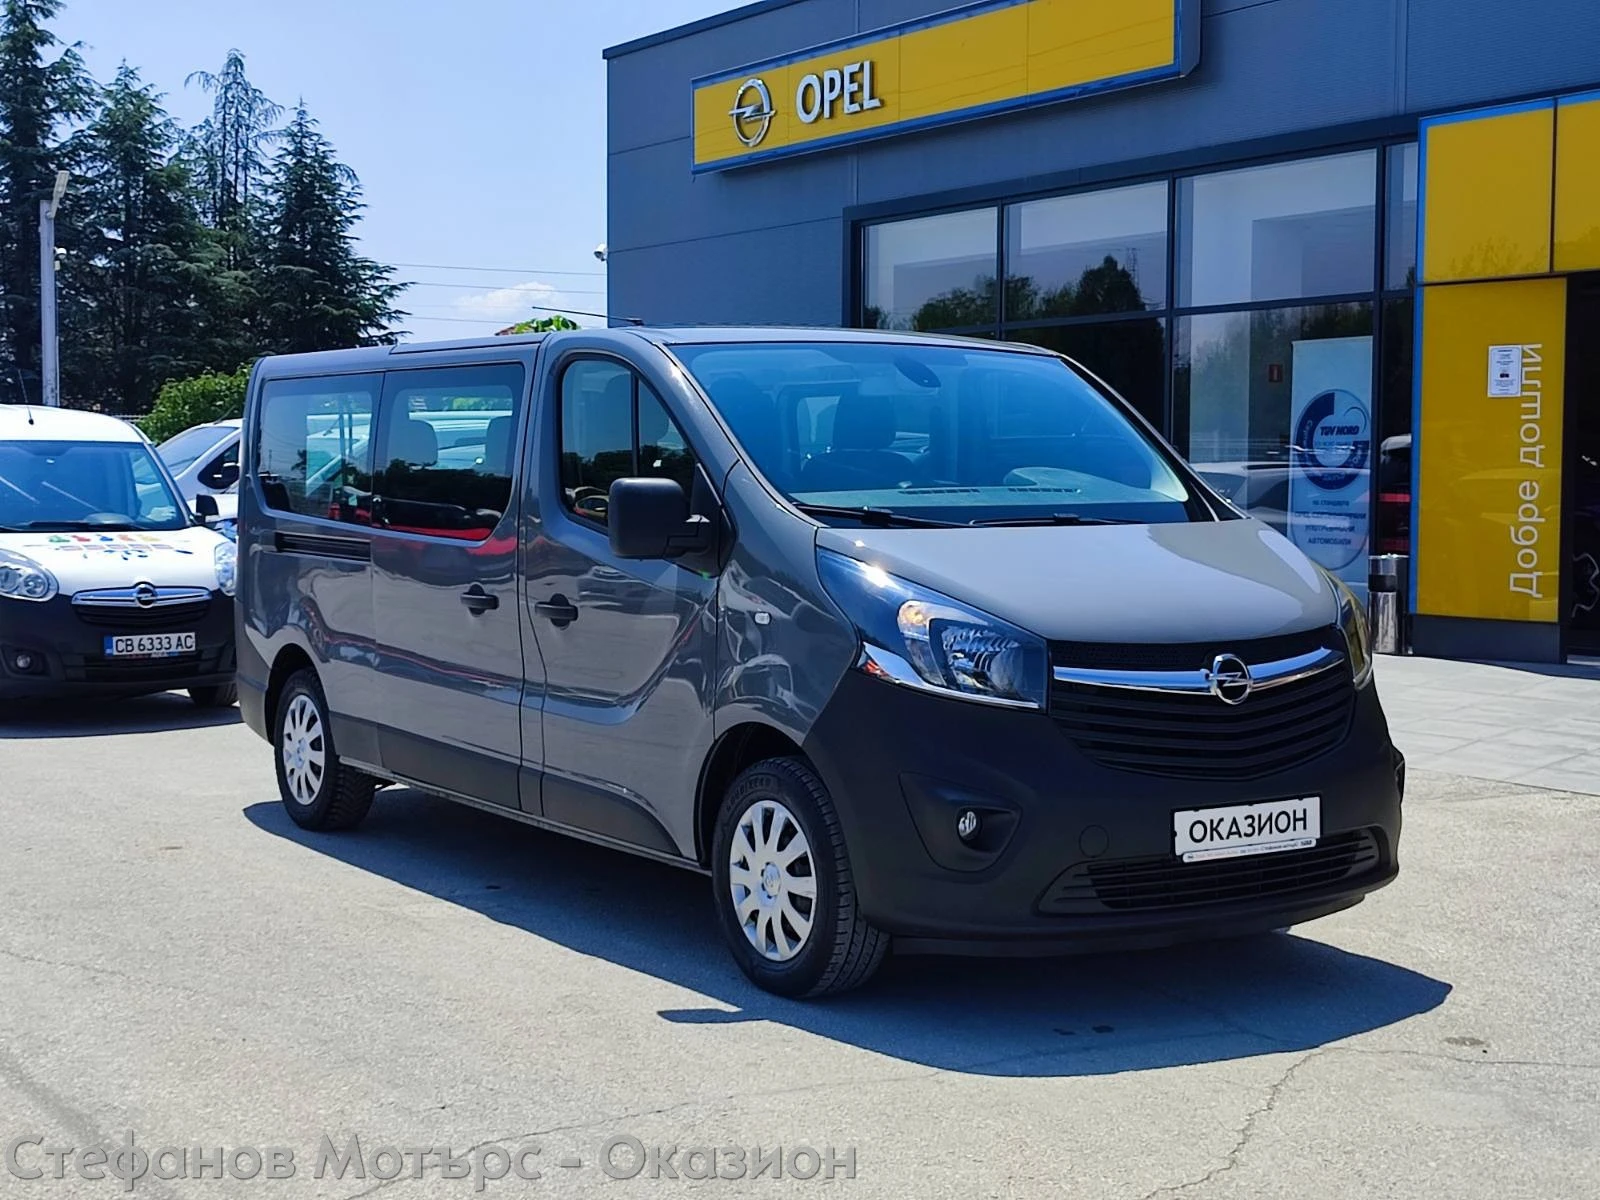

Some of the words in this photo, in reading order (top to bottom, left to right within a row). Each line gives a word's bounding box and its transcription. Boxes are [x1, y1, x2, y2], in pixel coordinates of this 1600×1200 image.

[796, 60, 882, 124] OPEL
[1519, 343, 1546, 468] дошли
[1509, 480, 1546, 599] Добре
[115, 638, 135, 654] CB
[138, 636, 172, 652] 6333
[175, 634, 194, 650] AC
[1189, 808, 1308, 844] ОКАЗИОН
